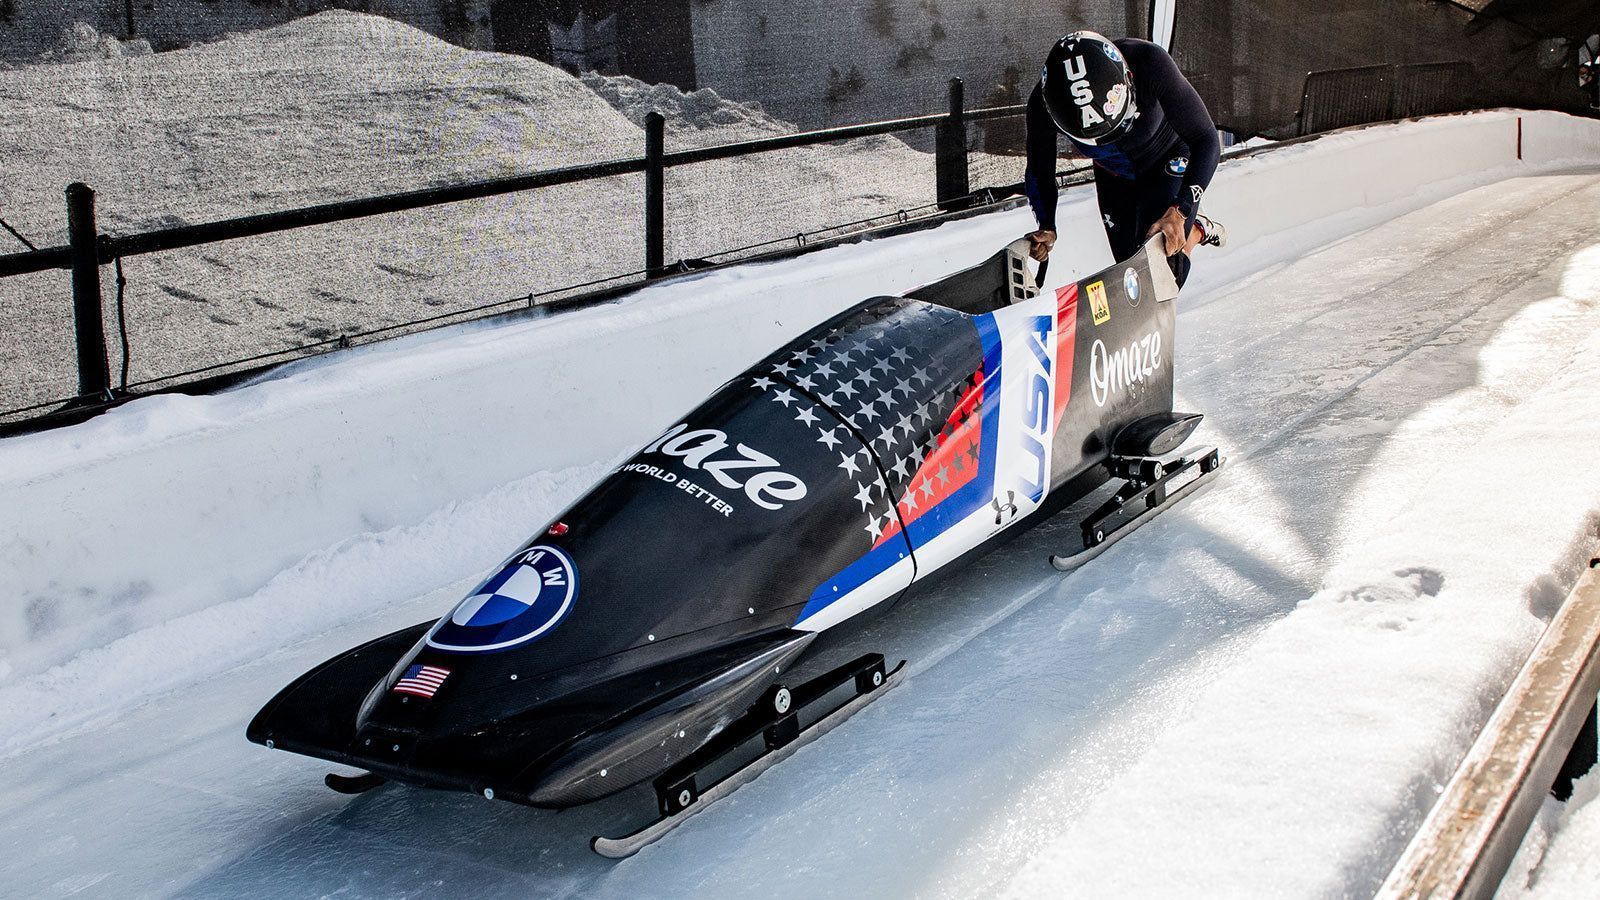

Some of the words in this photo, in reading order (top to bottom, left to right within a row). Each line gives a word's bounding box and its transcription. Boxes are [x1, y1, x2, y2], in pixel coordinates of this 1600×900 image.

[1063, 55, 1104, 129] USA
[1094, 310, 1108, 321] KOA
[1089, 330, 1162, 408] Omaze
[1017, 315, 1053, 503] USA
[623, 463, 677, 482] WORLD
[676, 478, 734, 518] BETTER
[643, 423, 808, 511] aze
[518, 550, 566, 586] MW
